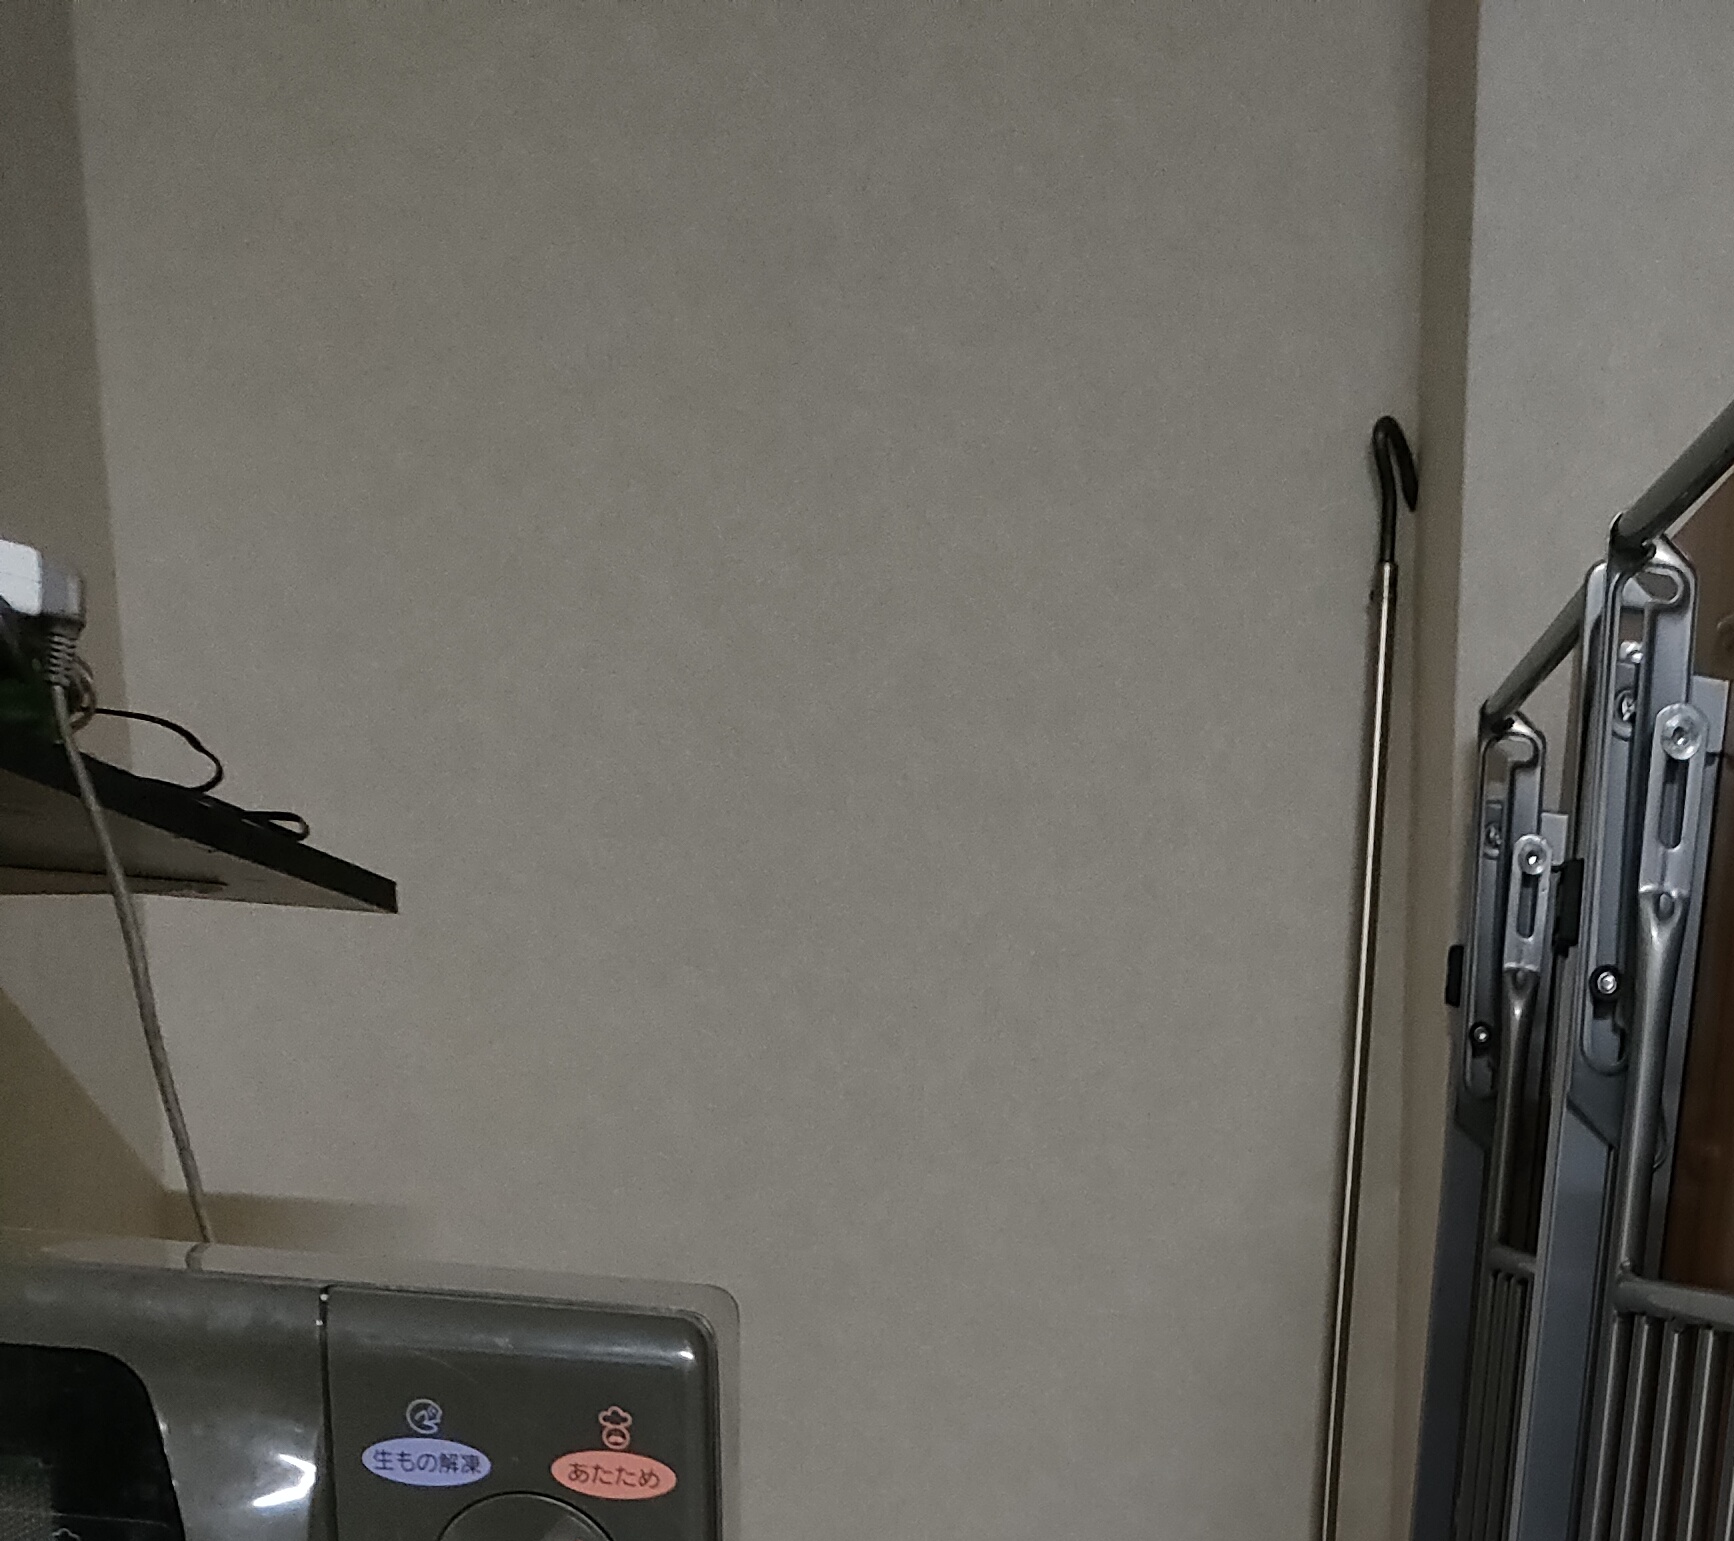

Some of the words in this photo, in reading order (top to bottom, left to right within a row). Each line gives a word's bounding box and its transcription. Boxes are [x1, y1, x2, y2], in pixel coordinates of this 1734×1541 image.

[373, 1450, 482, 1475] 生もの解凍
[567, 1462, 661, 1490] あたため
